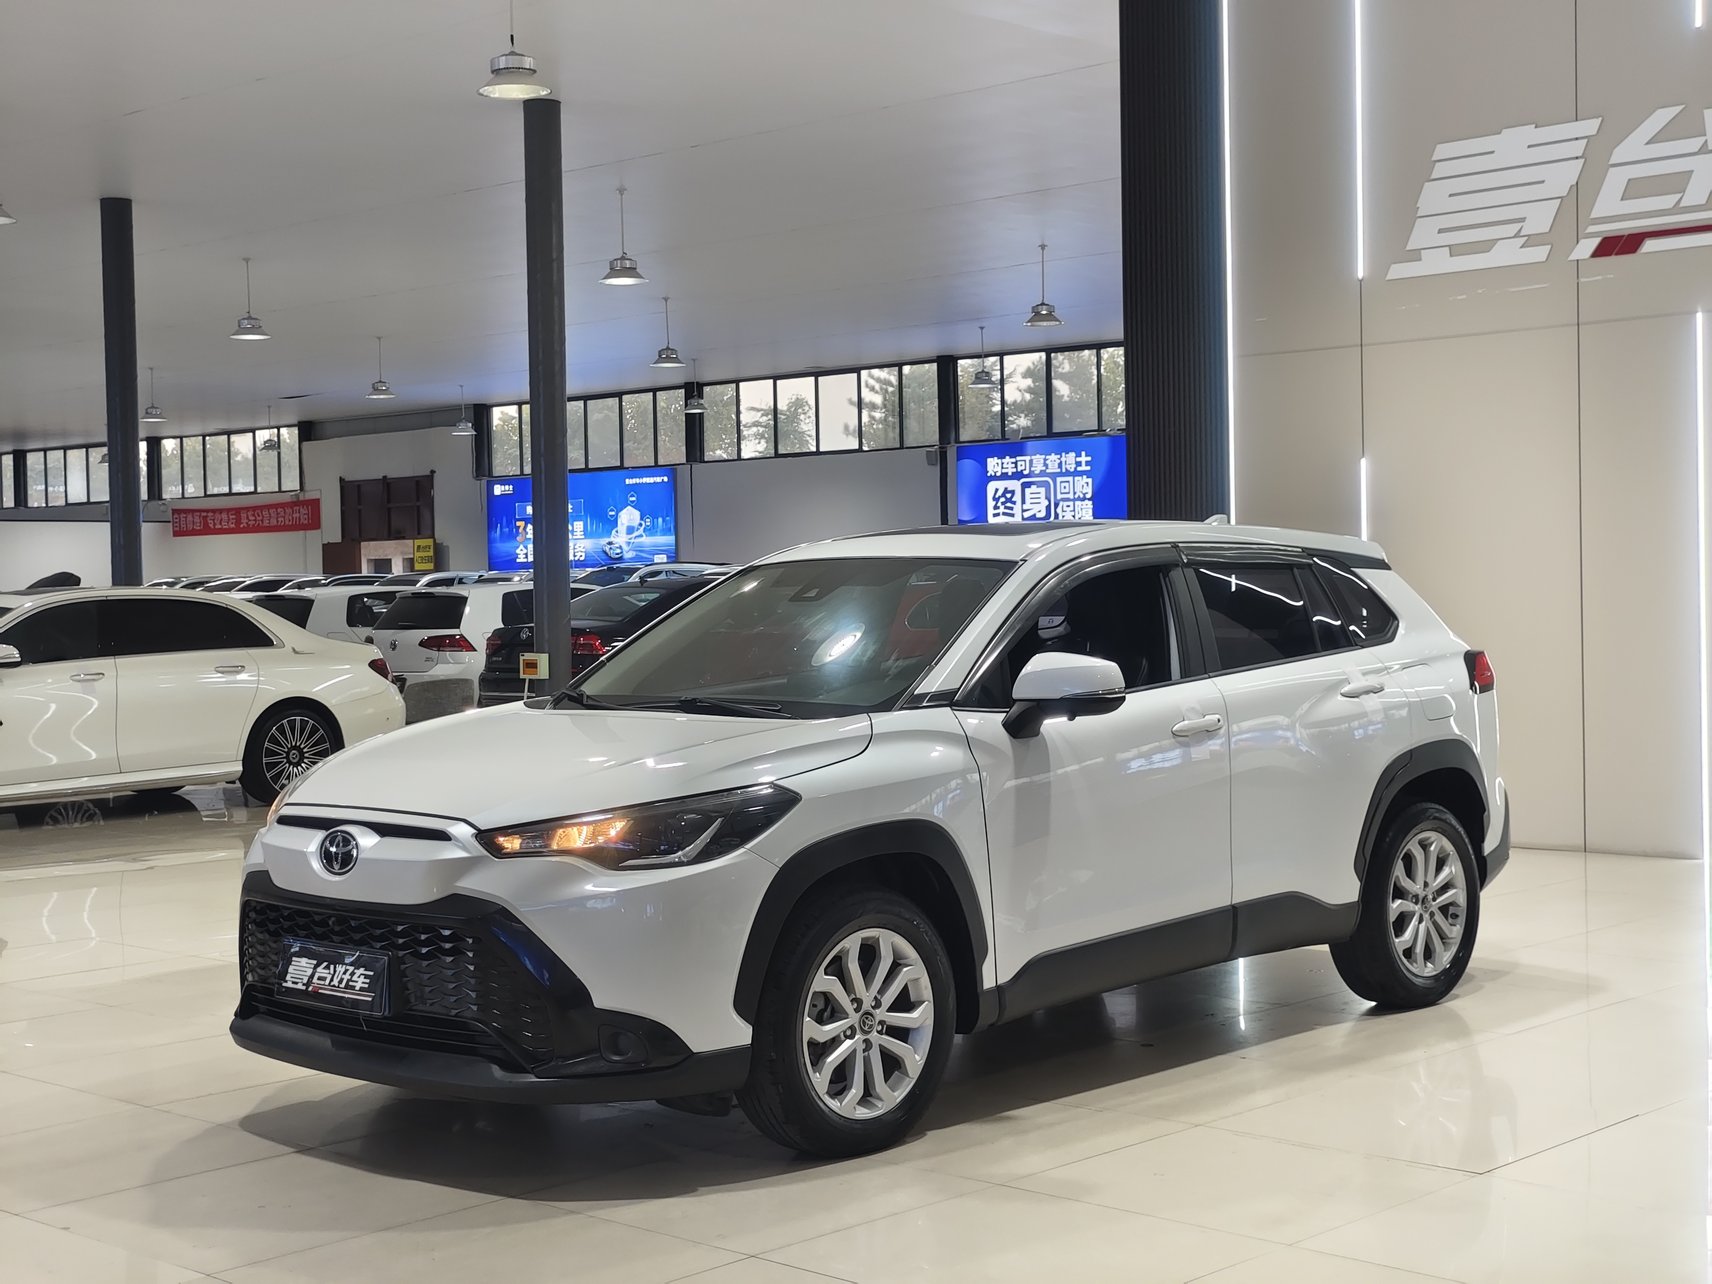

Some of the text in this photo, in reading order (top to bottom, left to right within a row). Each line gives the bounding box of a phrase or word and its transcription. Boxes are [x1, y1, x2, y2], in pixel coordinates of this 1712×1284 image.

[1385, 105, 1712, 280] 壹台
[986, 451, 1092, 477] 购车可享查博士
[992, 485, 1050, 519] 终身
[1056, 475, 1093, 500] 回购
[1056, 501, 1094, 520] 保障
[282, 957, 375, 991] 壹台好车
